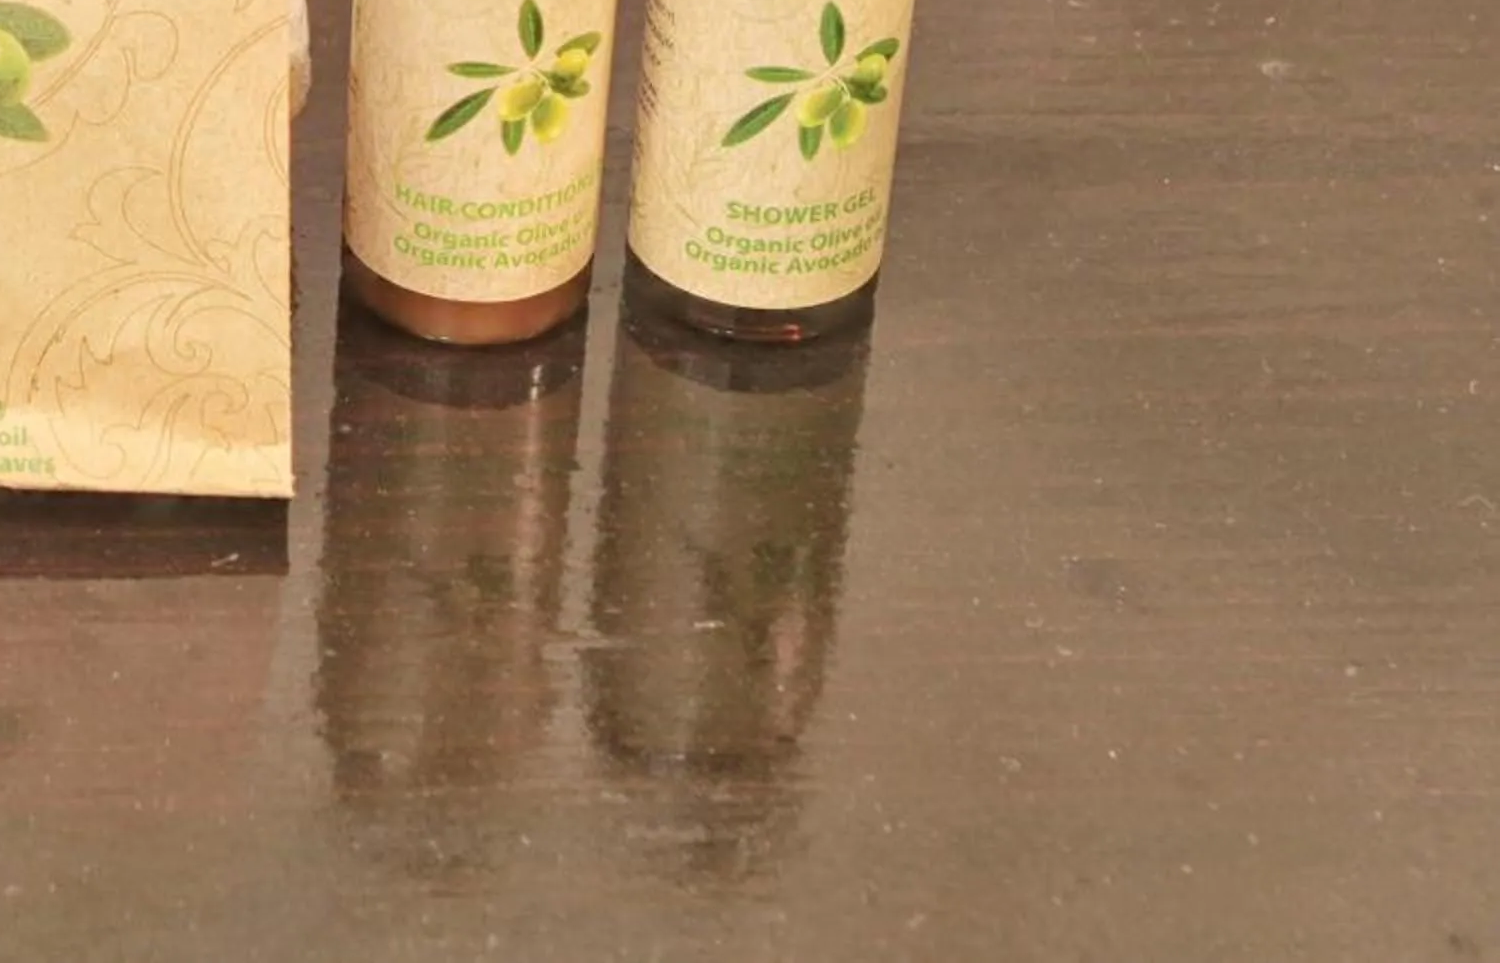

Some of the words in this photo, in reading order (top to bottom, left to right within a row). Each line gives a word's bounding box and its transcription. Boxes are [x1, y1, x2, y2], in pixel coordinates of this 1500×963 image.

[395, 184, 454, 215] HAIR
[726, 201, 838, 225] SHOWER
[843, 188, 877, 214] GEL
[414, 222, 510, 249] Organic
[516, 217, 569, 246] Olive
[706, 226, 806, 254] Organic
[811, 223, 864, 251] Olive
[394, 235, 487, 268] Organic
[685, 239, 778, 274] Organic
[786, 237, 873, 275] Avocado
